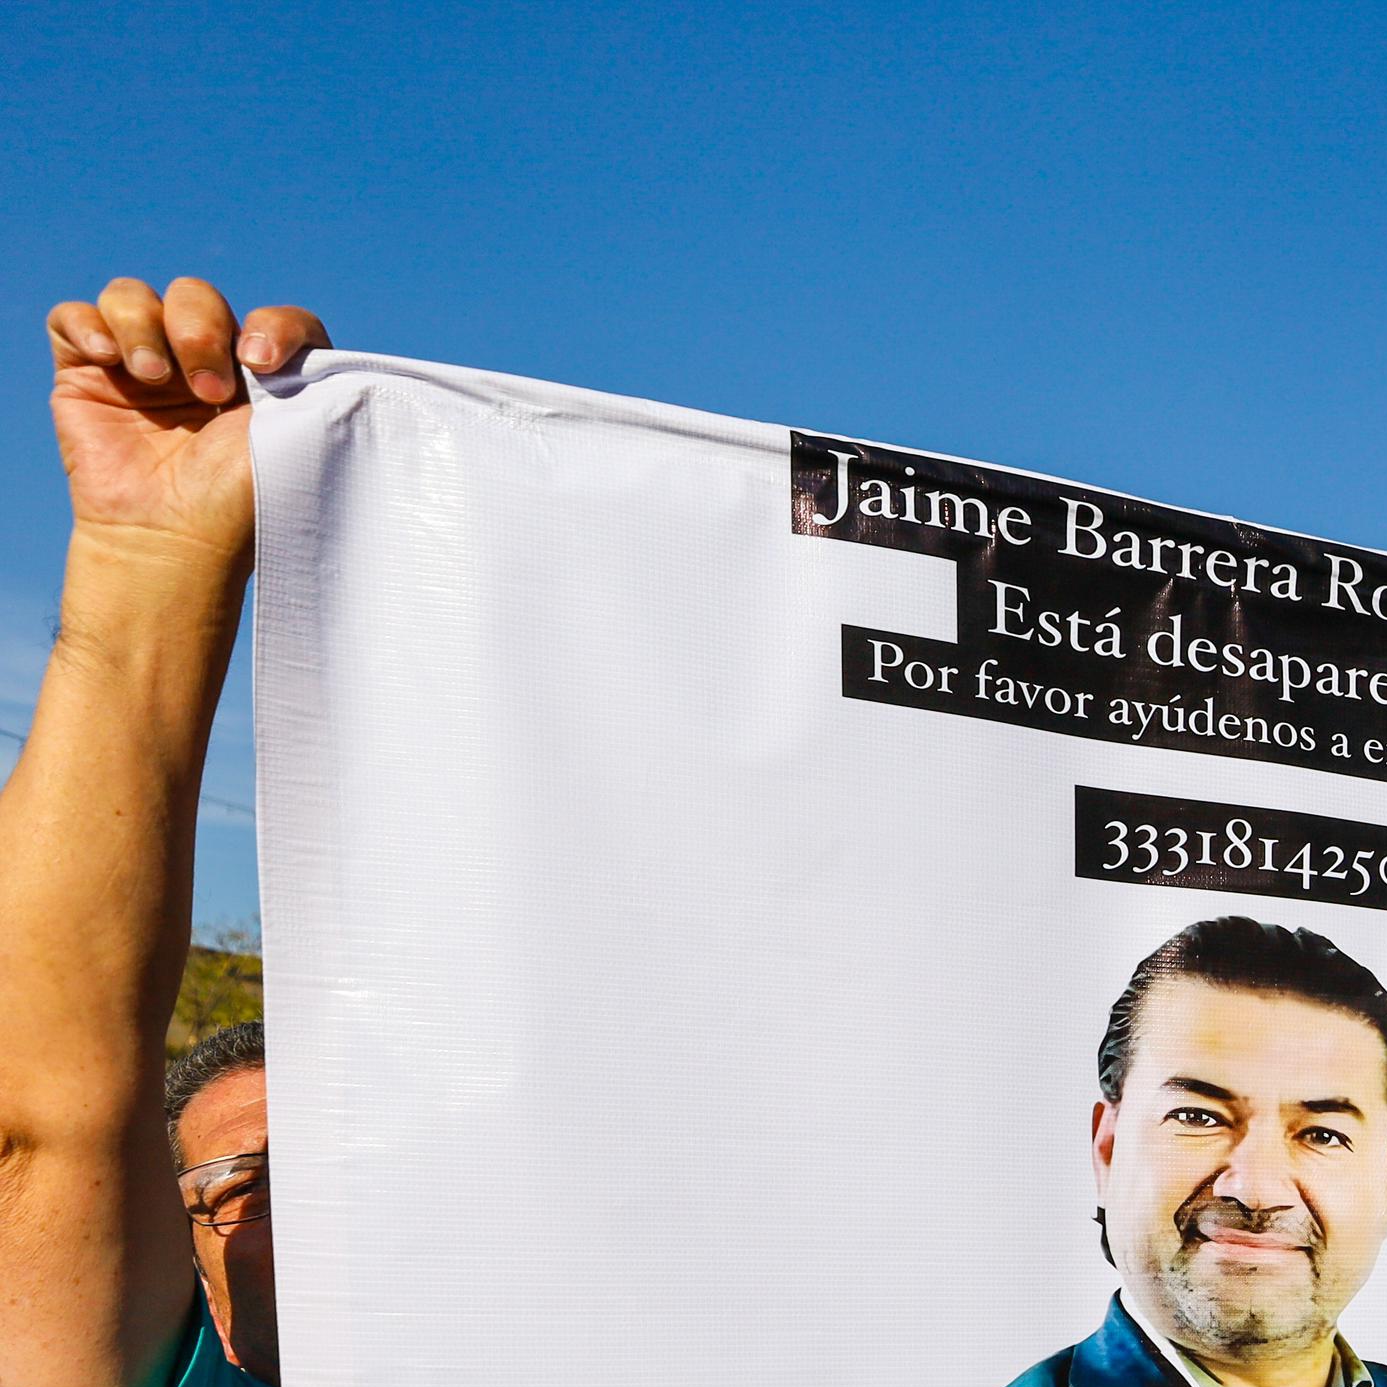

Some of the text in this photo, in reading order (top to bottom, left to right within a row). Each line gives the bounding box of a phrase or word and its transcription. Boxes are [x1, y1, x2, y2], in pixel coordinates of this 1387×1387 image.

[814, 449, 1032, 546] Jaime
[1059, 497, 1303, 602] Barrera
[989, 579, 1125, 659] Está
[868, 640, 958, 695] Por
[974, 660, 1095, 719] favor
[1109, 694, 1317, 746] ayúdenos
[1331, 733, 1352, 759] a
